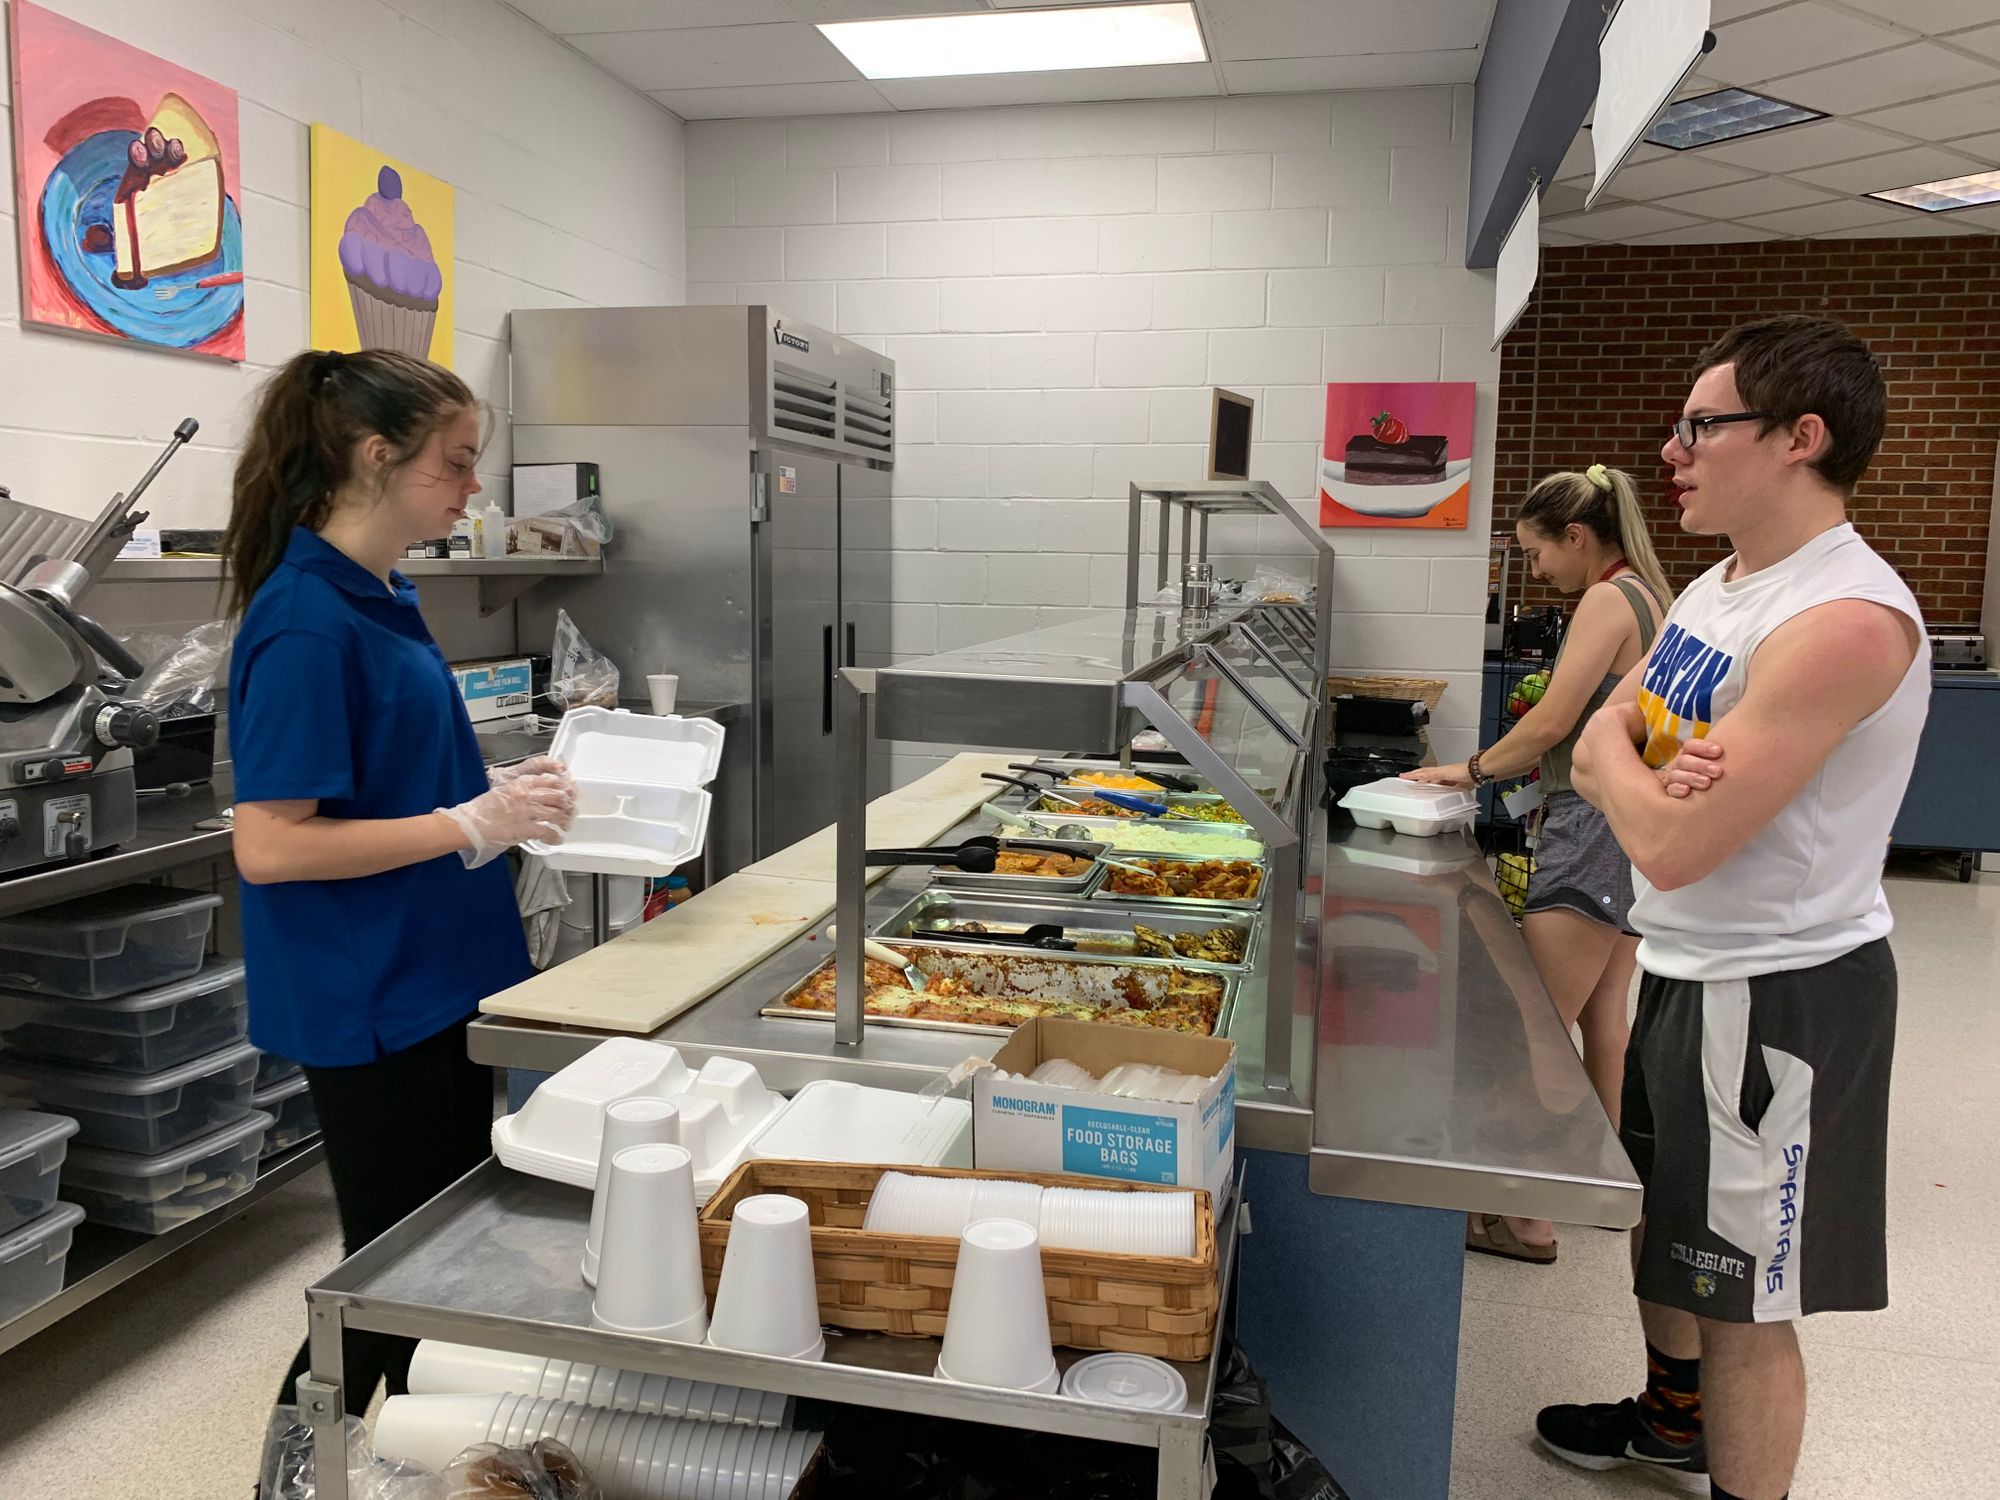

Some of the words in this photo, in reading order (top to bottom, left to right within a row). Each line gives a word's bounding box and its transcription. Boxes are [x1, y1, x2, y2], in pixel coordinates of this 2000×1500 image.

[992, 1095, 1056, 1116] MONOGRAM
[1067, 1128, 1103, 1146] FOOD
[1107, 1133, 1173, 1155] STORAGE
[1101, 1148, 1139, 1166] BAGS
